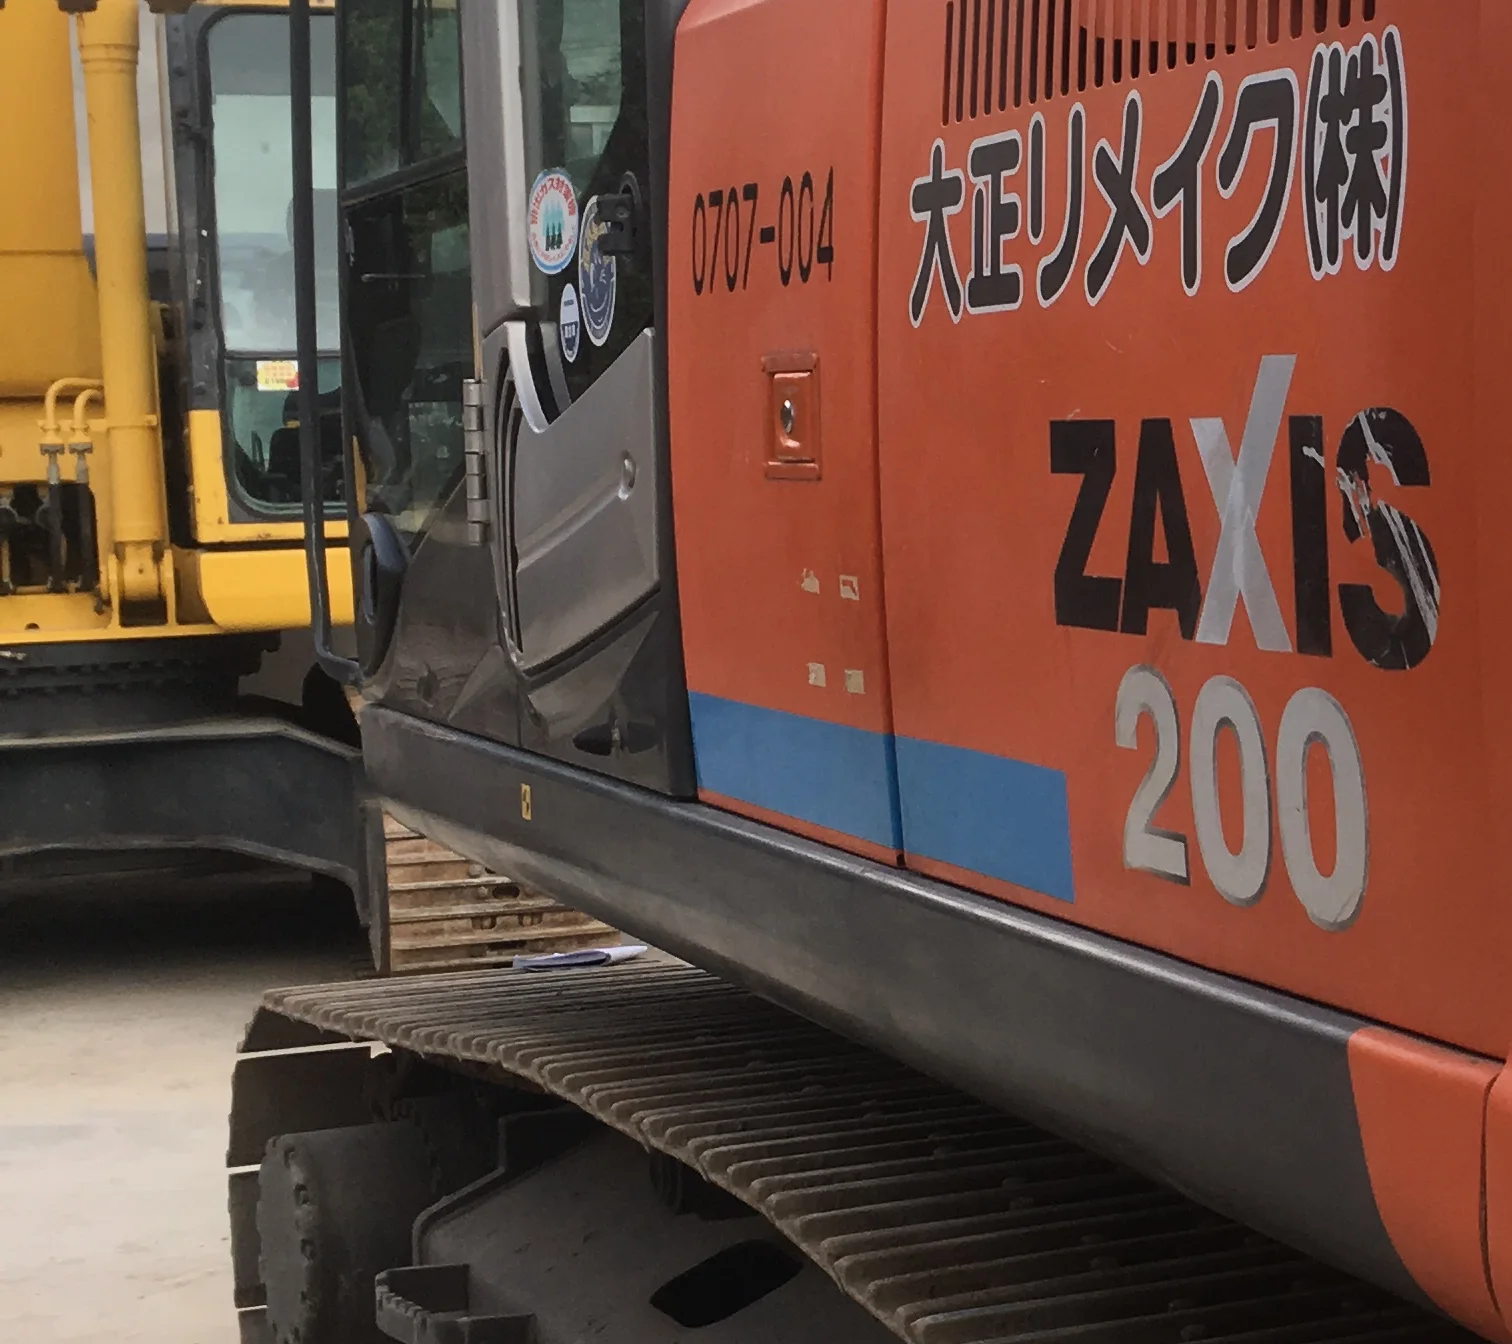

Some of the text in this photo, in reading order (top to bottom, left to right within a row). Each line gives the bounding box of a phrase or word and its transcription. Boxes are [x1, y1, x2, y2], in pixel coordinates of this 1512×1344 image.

[692, 166, 834, 296] 0707-004
[909, 24, 1408, 328] 大正リメイク(株)
[1049, 354, 1441, 671] ZAXIS
[1115, 663, 1370, 932] 200
